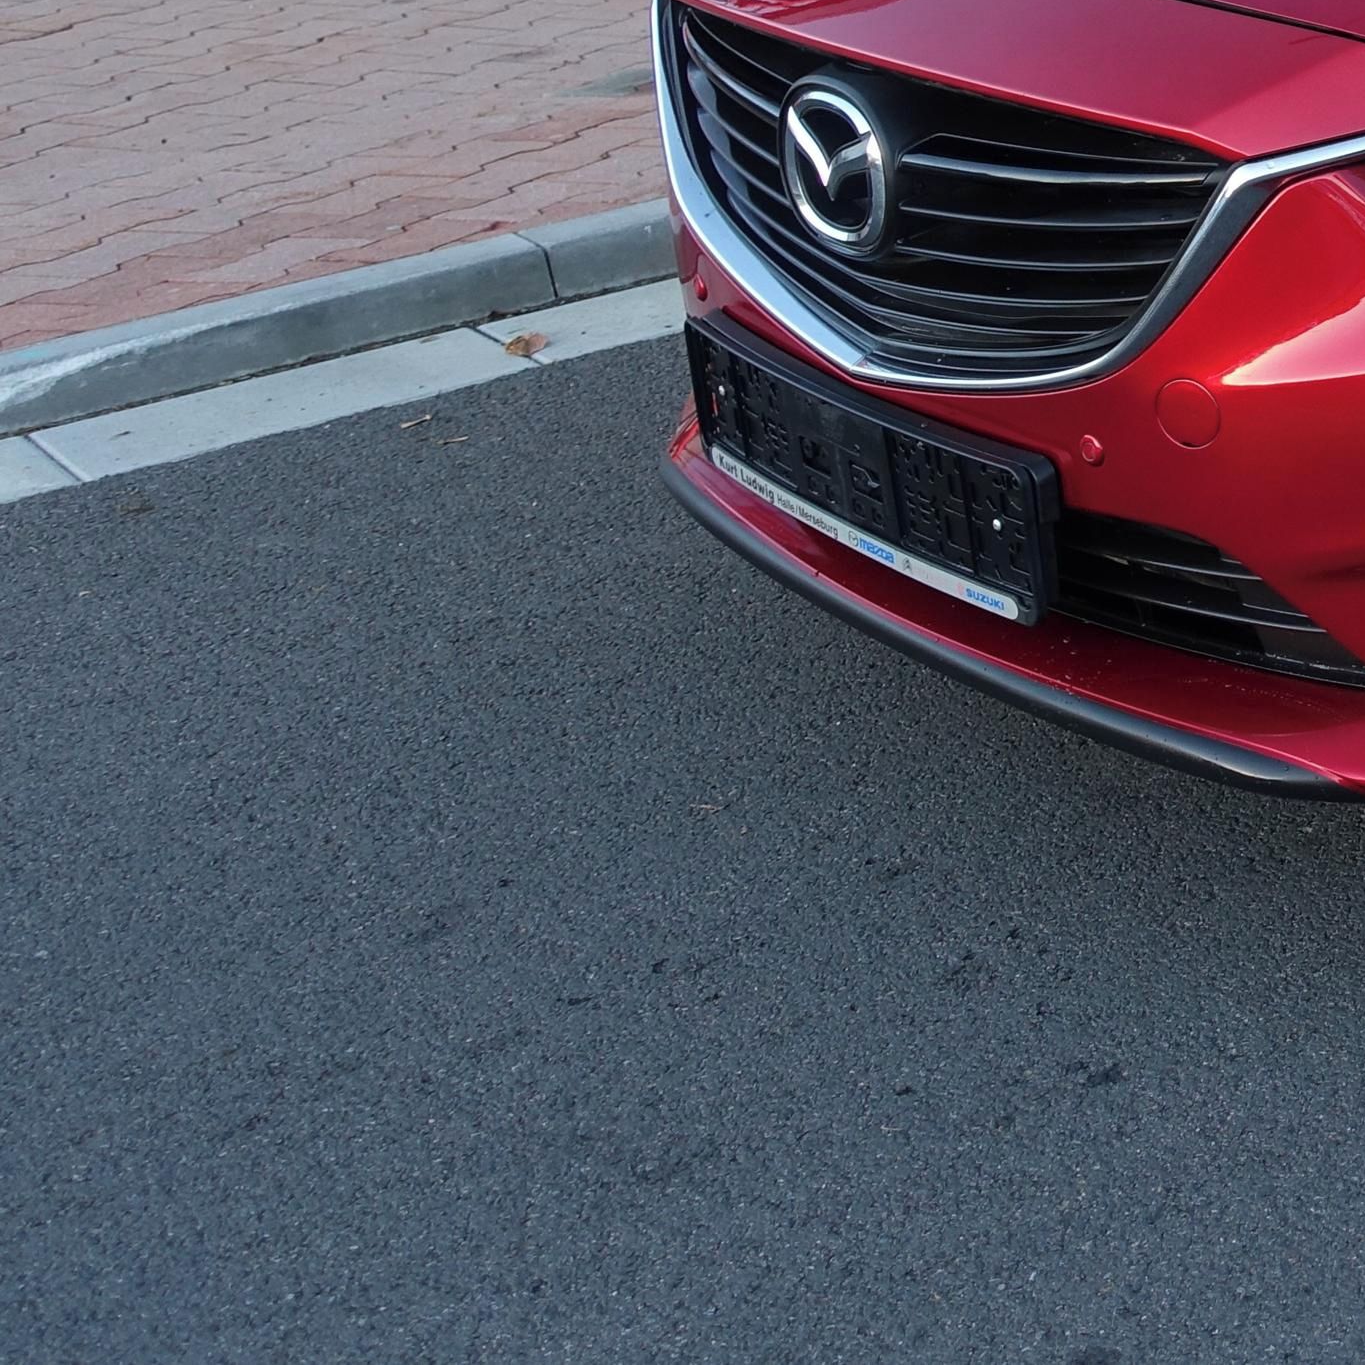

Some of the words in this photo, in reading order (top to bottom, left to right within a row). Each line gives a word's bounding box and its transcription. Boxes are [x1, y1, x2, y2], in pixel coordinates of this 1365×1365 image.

[719, 455, 738, 478] Kurt
[740, 468, 775, 505] Ludwig
[966, 587, 1005, 611] SUZUKI
